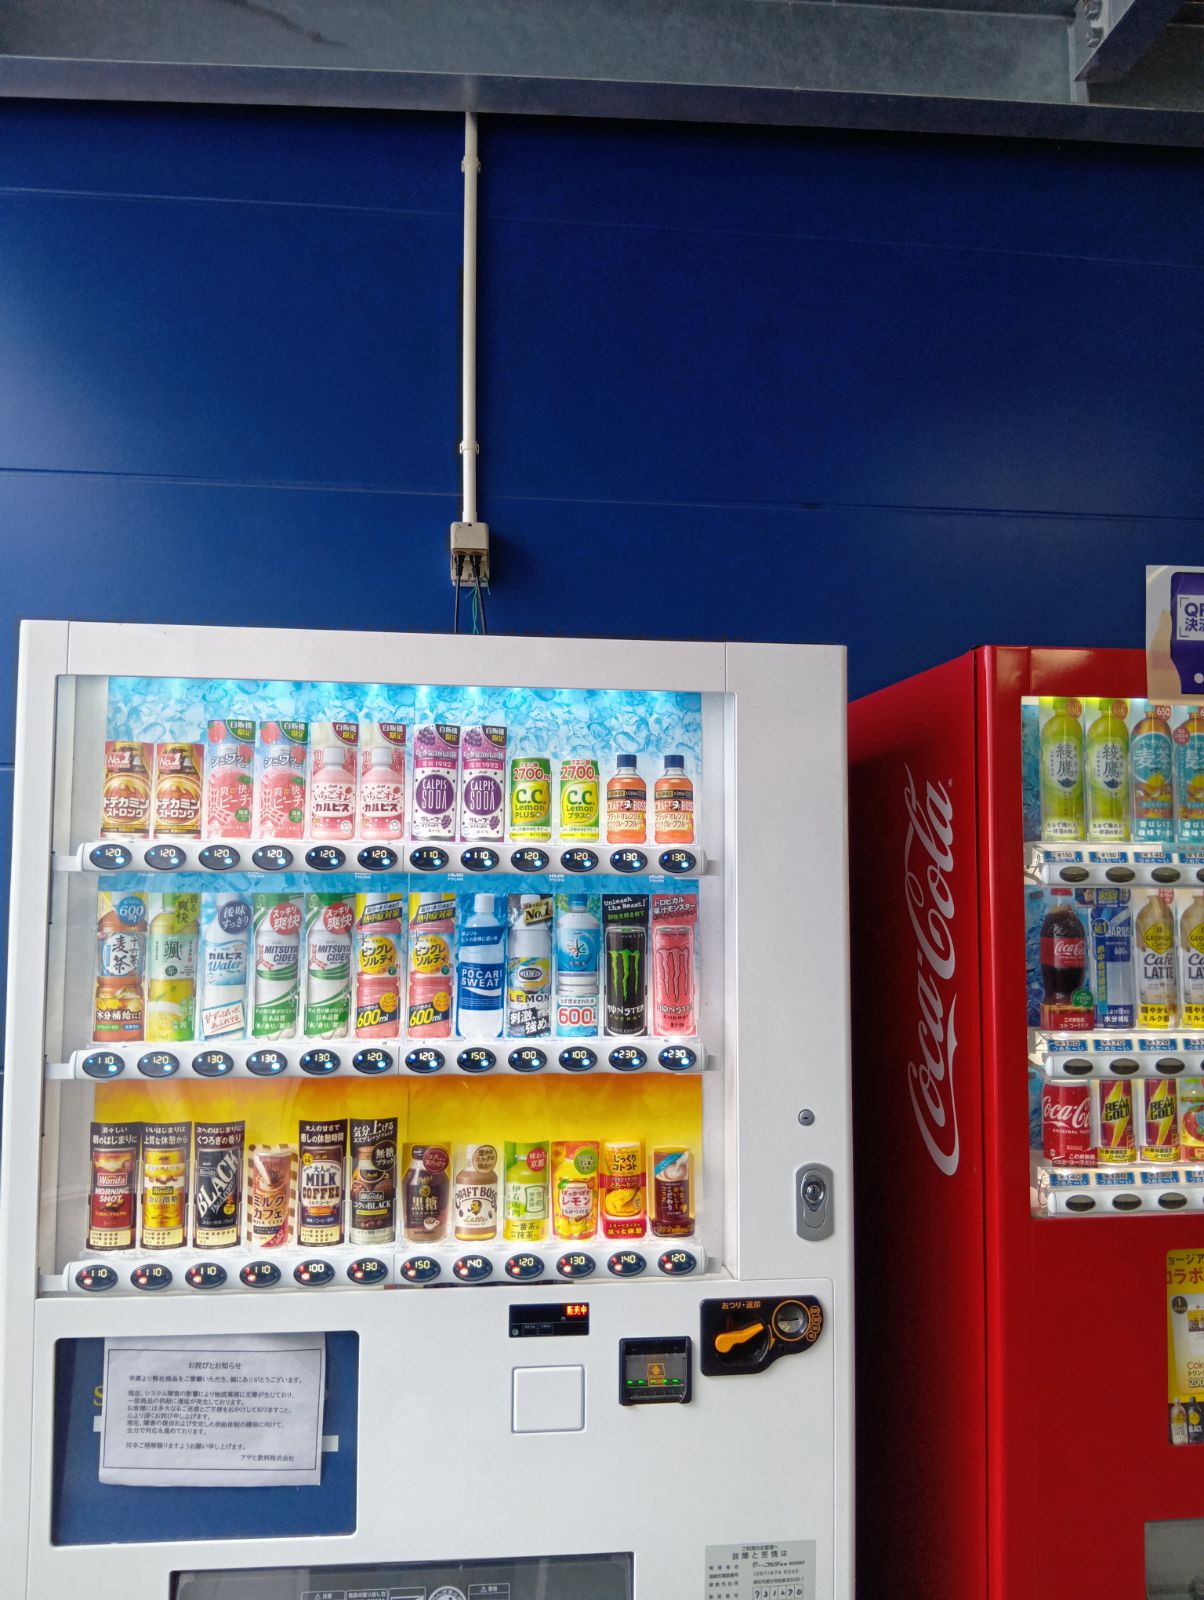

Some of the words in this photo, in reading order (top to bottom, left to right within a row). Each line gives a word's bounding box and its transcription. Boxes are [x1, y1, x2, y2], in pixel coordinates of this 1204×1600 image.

[422, 780, 447, 790] CALPIS
[470, 780, 495, 790] CALPIS
[422, 790, 447, 809] SODA
[469, 791, 495, 811] SODA
[315, 803, 350, 812] カルピス
[364, 803, 398, 812] カルピス
[105, 848, 122, 857] 120
[160, 849, 176, 857] 120
[214, 849, 230, 858] 120
[267, 849, 283, 858] 120
[320, 850, 336, 858] 120
[372, 850, 387, 858] 120
[524, 852, 539, 860] 120
[574, 852, 588, 860] 120
[622, 853, 637, 861] 130
[671, 853, 685, 861] 130
[208, 952, 242, 960] カルピス
[273, 953, 298, 962] CIDER
[461, 969, 502, 979] POCARI
[1144, 966, 1174, 979] LATTE
[461, 978, 500, 987] SWEAT
[261, 1054, 277, 1063] 130
[314, 1053, 330, 1062] 130
[367, 1053, 383, 1061] 120
[420, 1052, 435, 1060] 120
[471, 1051, 486, 1060] 150
[522, 1051, 537, 1059] 100
[572, 1050, 587, 1059] 100
[619, 1050, 637, 1059] 230
[669, 1050, 686, 1058] 230
[98, 1056, 115, 1065] 110
[152, 1055, 169, 1064] 120
[207, 1055, 224, 1064] 130
[613, 1154, 637, 1163] じっくり
[612, 1163, 637, 1171] コトコト
[197, 1150, 239, 1218] BLACK
[305, 1173, 337, 1187] MILK
[302, 1186, 340, 1200] COFFEE
[99, 1194, 124, 1203] SHOT
[253, 1195, 285, 1208] ミルク
[561, 1197, 591, 1206] レモン
[253, 1209, 284, 1219] カフェ
[519, 1258, 534, 1266] 120
[570, 1256, 585, 1265] 130
[621, 1255, 636, 1263] 140
[671, 1253, 686, 1262] 120
[309, 1263, 325, 1272] 100
[362, 1262, 378, 1271] 130
[415, 1260, 430, 1269] 150
[467, 1259, 483, 1268] 140
[146, 1268, 162, 1277] 110
[200, 1267, 217, 1275] 110
[255, 1264, 271, 1273] 110
[91, 1269, 108, 1278] 110
